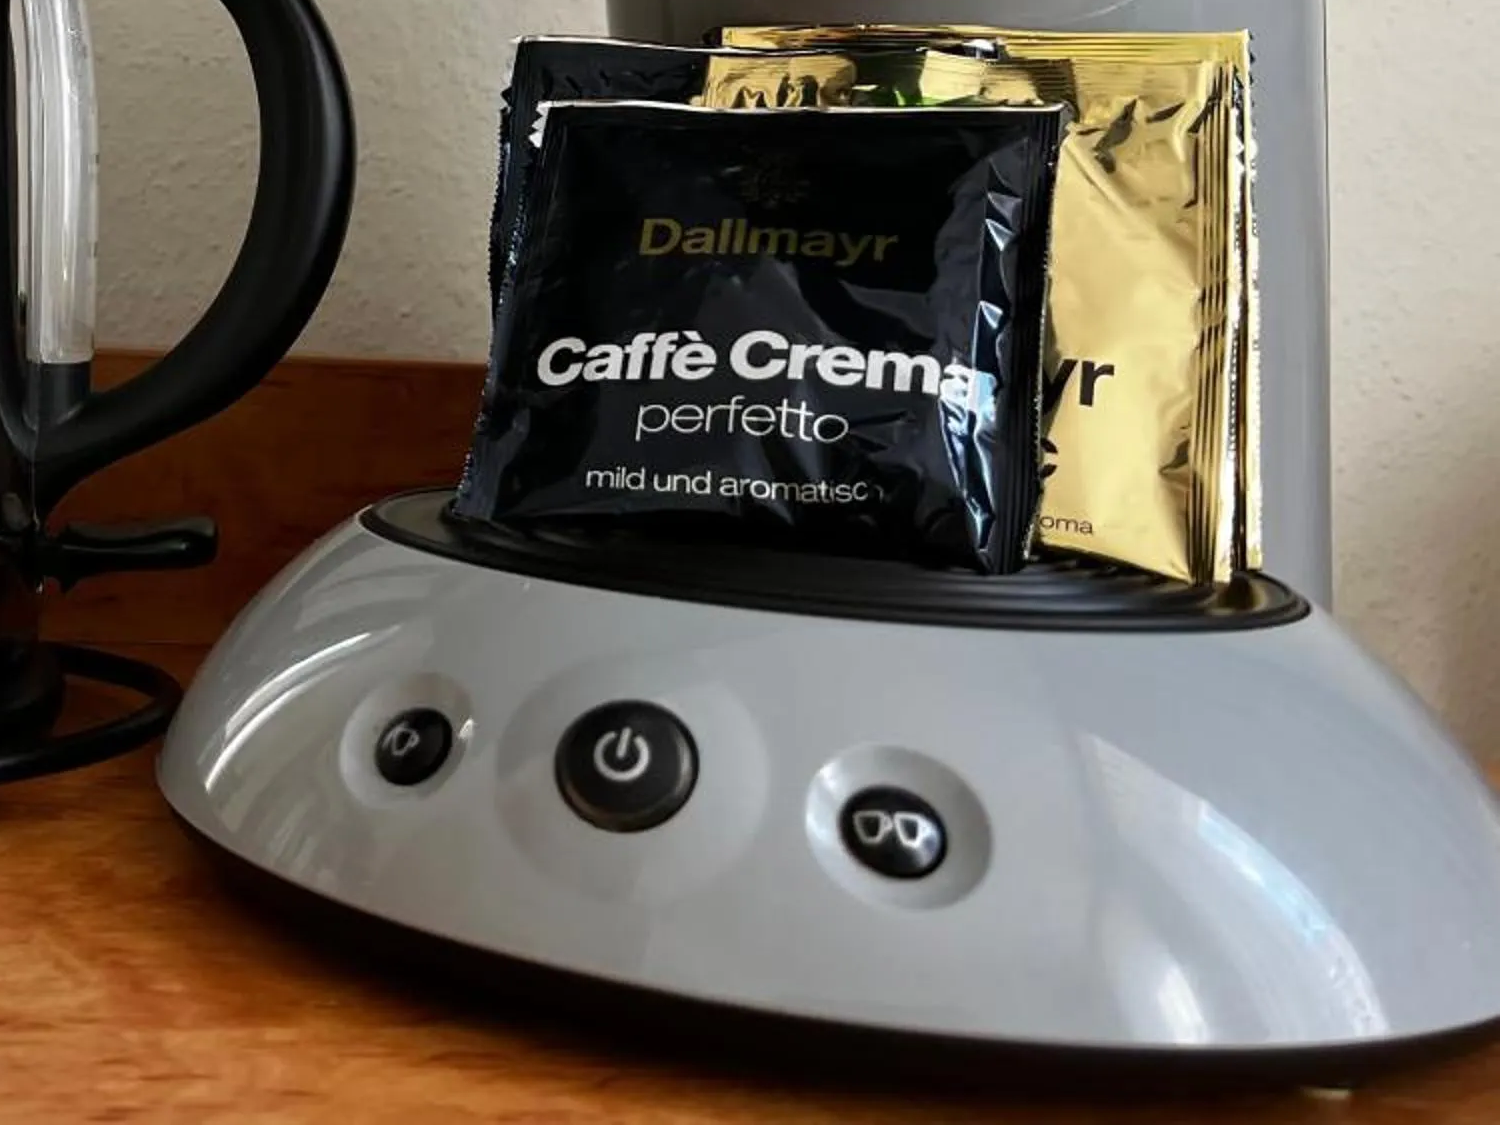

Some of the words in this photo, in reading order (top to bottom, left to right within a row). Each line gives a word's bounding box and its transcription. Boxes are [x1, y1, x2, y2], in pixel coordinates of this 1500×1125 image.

[638, 218, 899, 263] Dallmayr
[536, 331, 715, 388] Caffè
[728, 329, 989, 403] Crema
[635, 396, 850, 445] perfetto
[585, 467, 647, 492] mild
[653, 471, 711, 495] und
